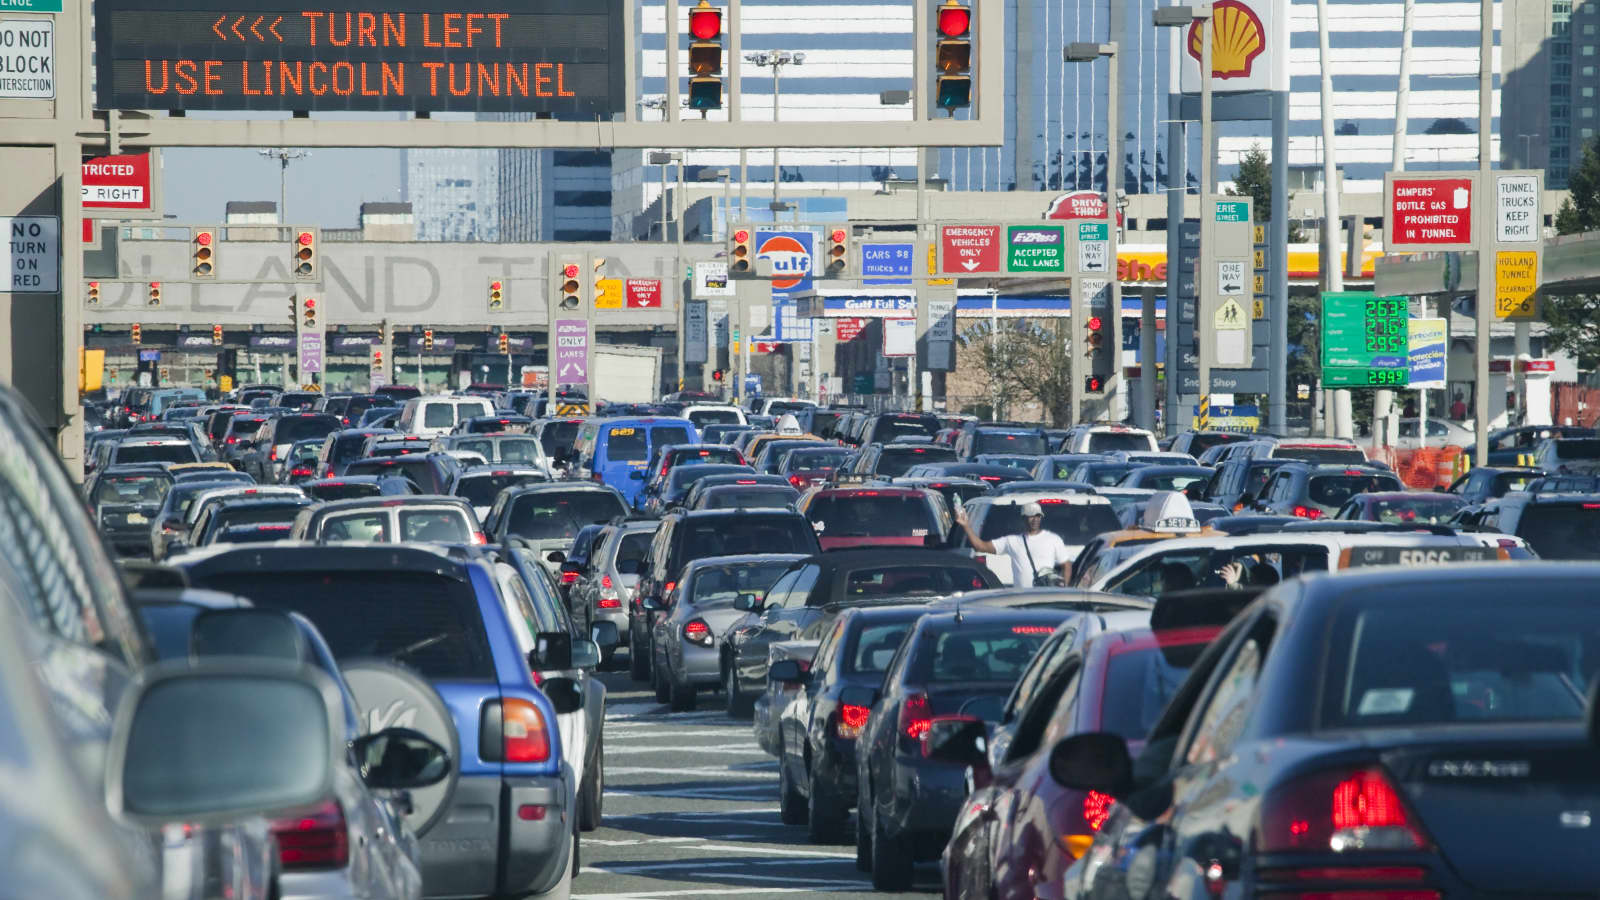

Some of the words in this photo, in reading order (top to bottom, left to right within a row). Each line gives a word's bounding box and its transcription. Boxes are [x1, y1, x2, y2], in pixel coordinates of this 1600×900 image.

[302, 11, 405, 48] TURN
[423, 13, 509, 49] LEFT
[19, 30, 50, 48] NOT
[144, 59, 223, 97] USE
[242, 59, 404, 98] LINCOLN
[422, 61, 575, 98] TUNNEL
[1501, 183, 1534, 193] TUNNEL
[98, 189, 140, 200] RIGHT
[1072, 198, 1103, 207] DRIVE
[1396, 201, 1426, 210] BOTTLE
[1430, 201, 1446, 210] GAS
[1501, 197, 1535, 207] TRUCKS
[1074, 207, 1101, 216] THRU
[1217, 204, 1237, 213] ERIE
[1404, 215, 1459, 224] PROHIBITED
[1507, 211, 1529, 221] KEEP
[12, 223, 41, 237] NO
[946, 228, 995, 237] EMERGENCY
[1081, 225, 1099, 233] ERIE
[1405, 229, 1416, 238] IN
[1421, 228, 1457, 239] TUNNEL
[1504, 225, 1530, 235] RIGHT
[951, 238, 990, 247] VEHICLES
[9, 241, 46, 254] TURN
[1085, 243, 1102, 252] ONE
[866, 250, 891, 259] CARS
[960, 248, 982, 257] ONLY
[1014, 249, 1058, 257] ACCEPTED
[1085, 252, 1102, 260] WAY
[16, 258, 38, 270] ON
[1013, 259, 1029, 267] ALL
[1033, 259, 1060, 267] LANES
[1499, 257, 1534, 267] HOLLAND
[1222, 264, 1241, 273] ONE
[1222, 273, 1241, 281] WAY
[1502, 270, 1531, 279] TUNNEL
[13, 274, 41, 286] RED
[845, 298, 873, 309] Gulf
[875, 298, 896, 309] Full
[560, 337, 584, 346] ONLY
[560, 350, 585, 359] LANES
[1213, 377, 1237, 388] Shop
[1220, 406, 1233, 417] Try
[1365, 550, 1384, 561] OFF
